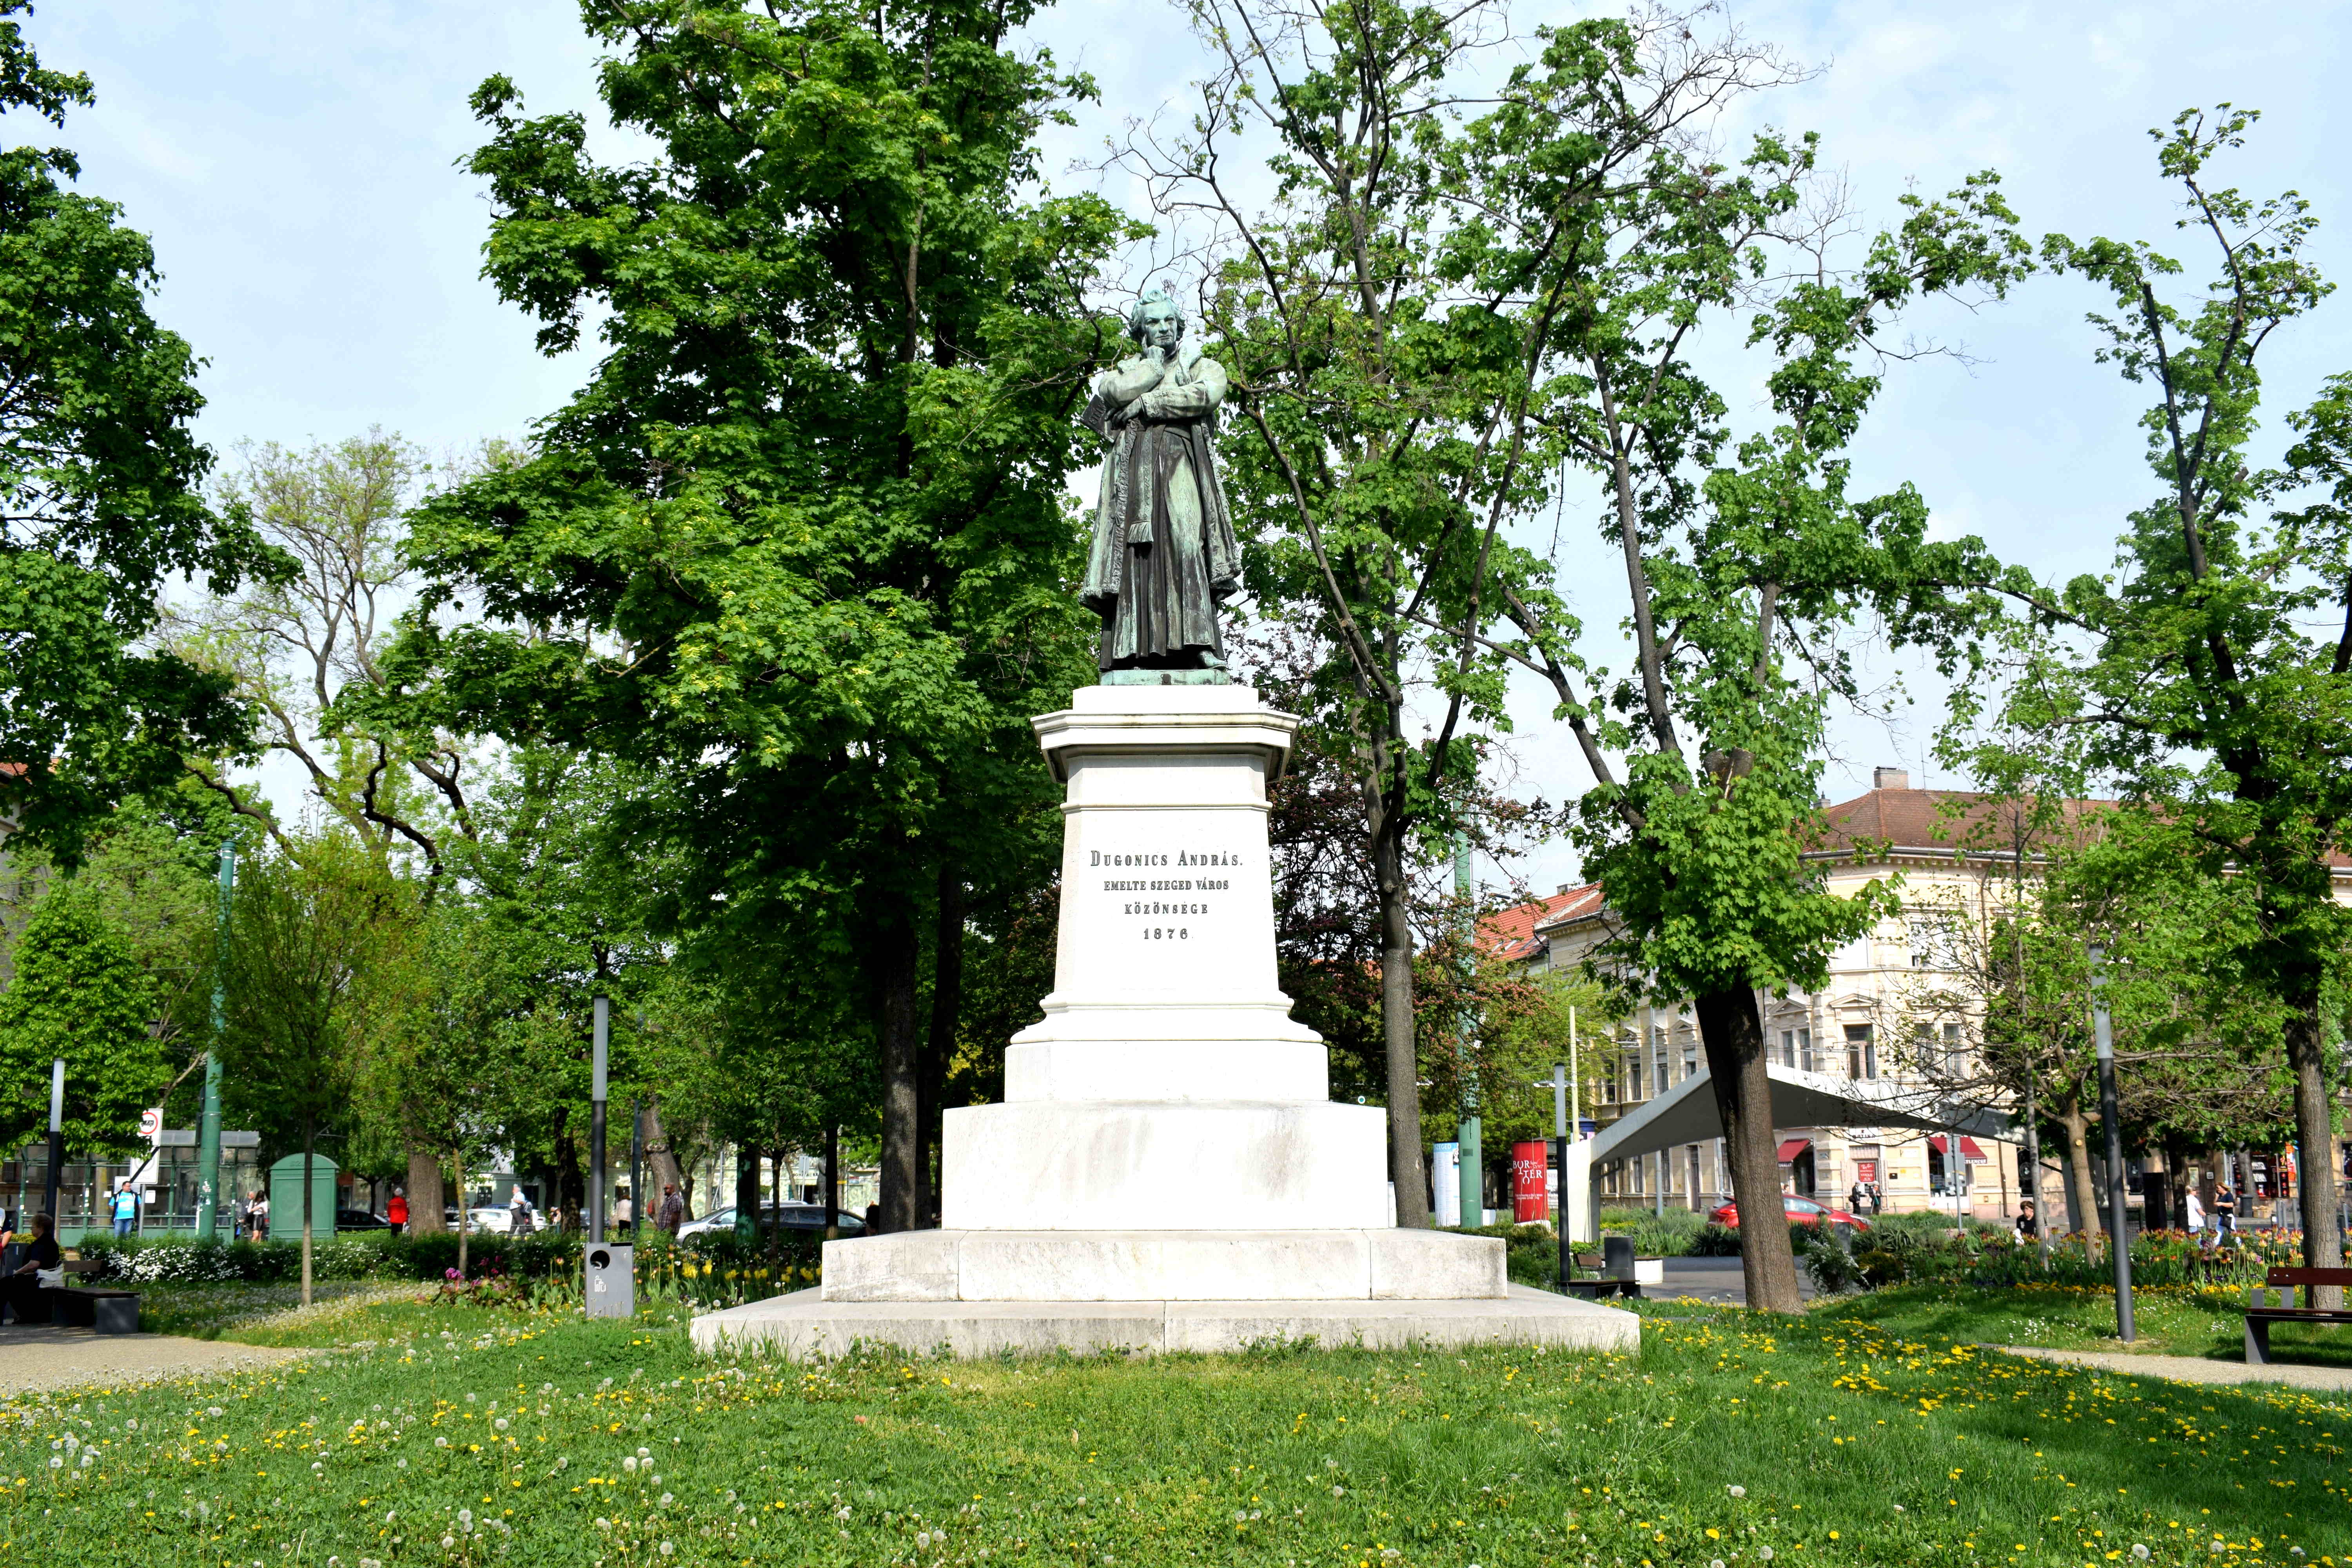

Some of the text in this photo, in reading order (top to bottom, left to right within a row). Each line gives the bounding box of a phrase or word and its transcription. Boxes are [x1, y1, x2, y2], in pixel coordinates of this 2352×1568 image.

[1091, 850, 1243, 866] DUGONICS ANDRÁS.
[1104, 877, 1229, 891] EMELTE SZEGED VÁROS
[1125, 902, 1208, 914] KÖZÖNSÉGE
[1144, 928, 1188, 939] 1876
